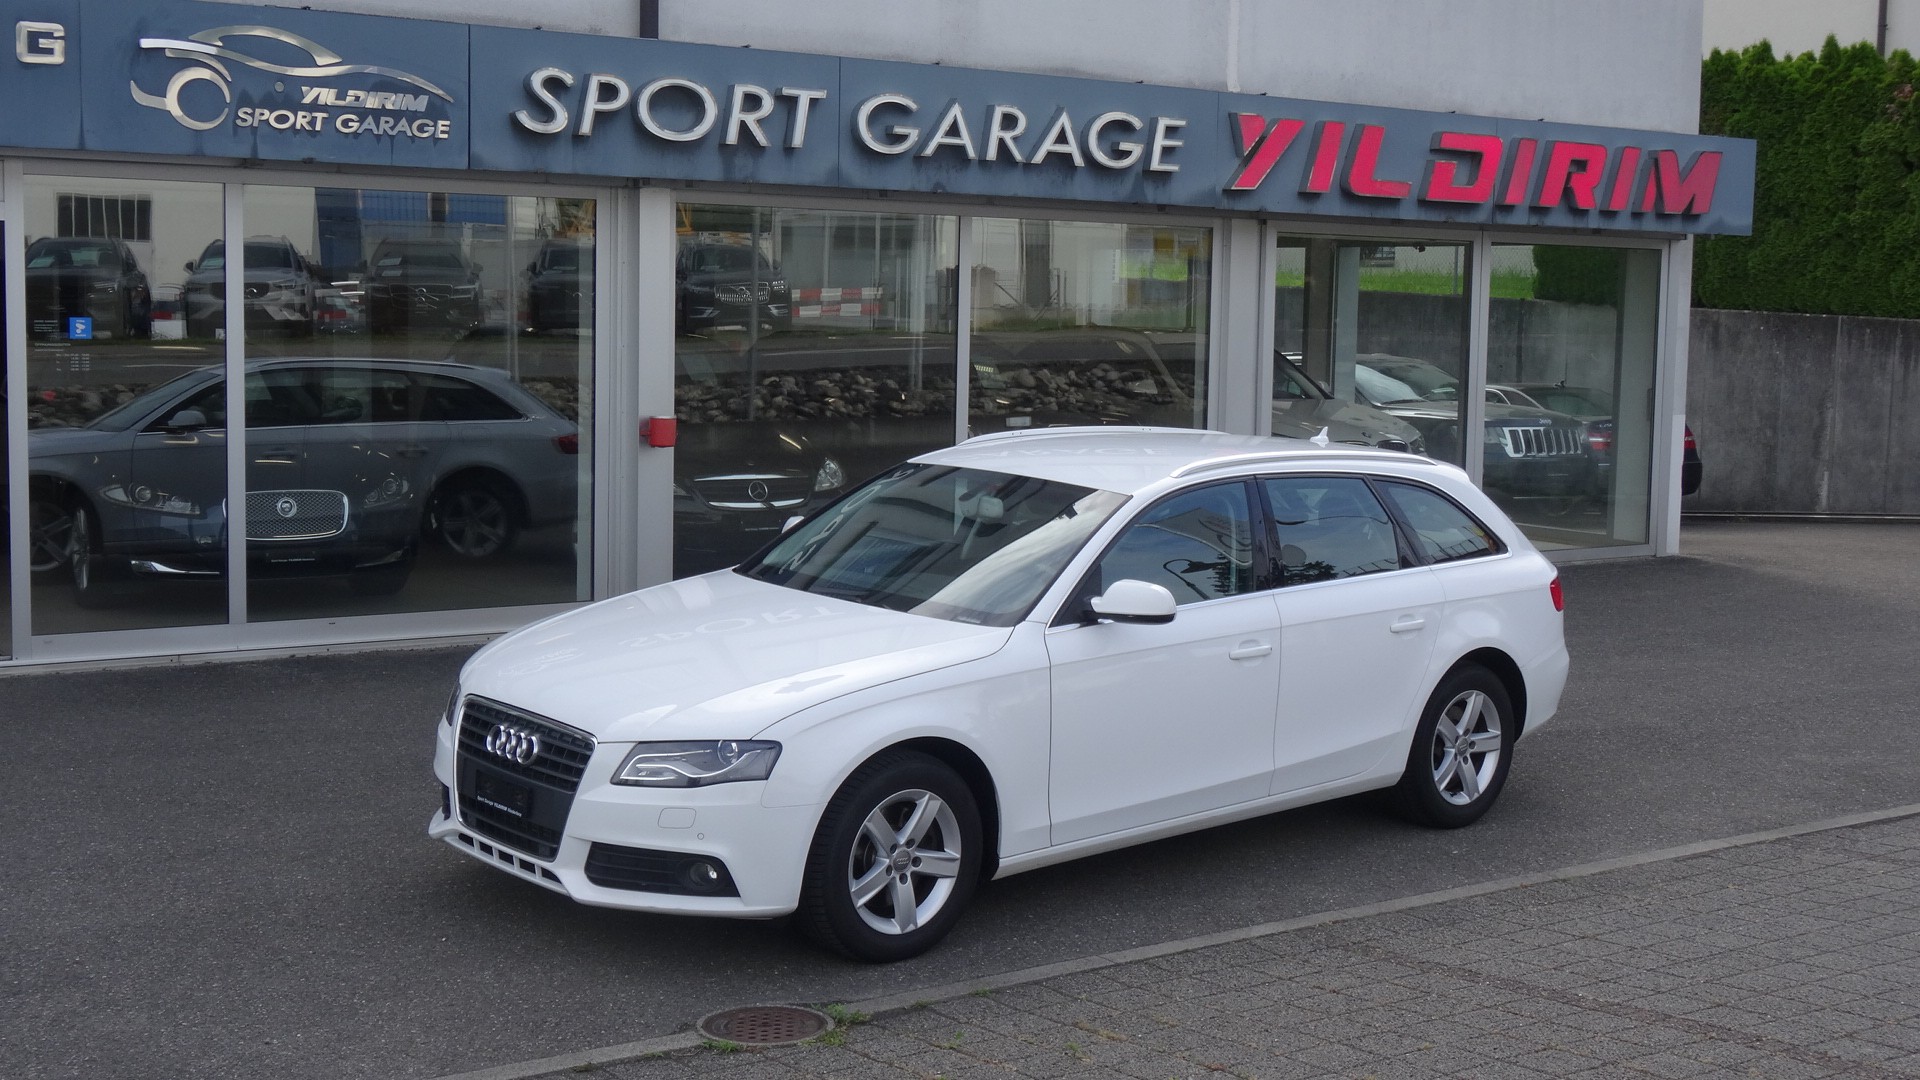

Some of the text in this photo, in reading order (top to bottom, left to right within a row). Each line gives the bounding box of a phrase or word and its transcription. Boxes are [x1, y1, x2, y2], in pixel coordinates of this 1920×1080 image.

[16, 21, 65, 65] G
[301, 86, 429, 112] YILDIRIM
[235, 107, 450, 139] SPORT GARAGE
[513, 66, 1723, 216] SPORT GARAGE YILDIRIM
